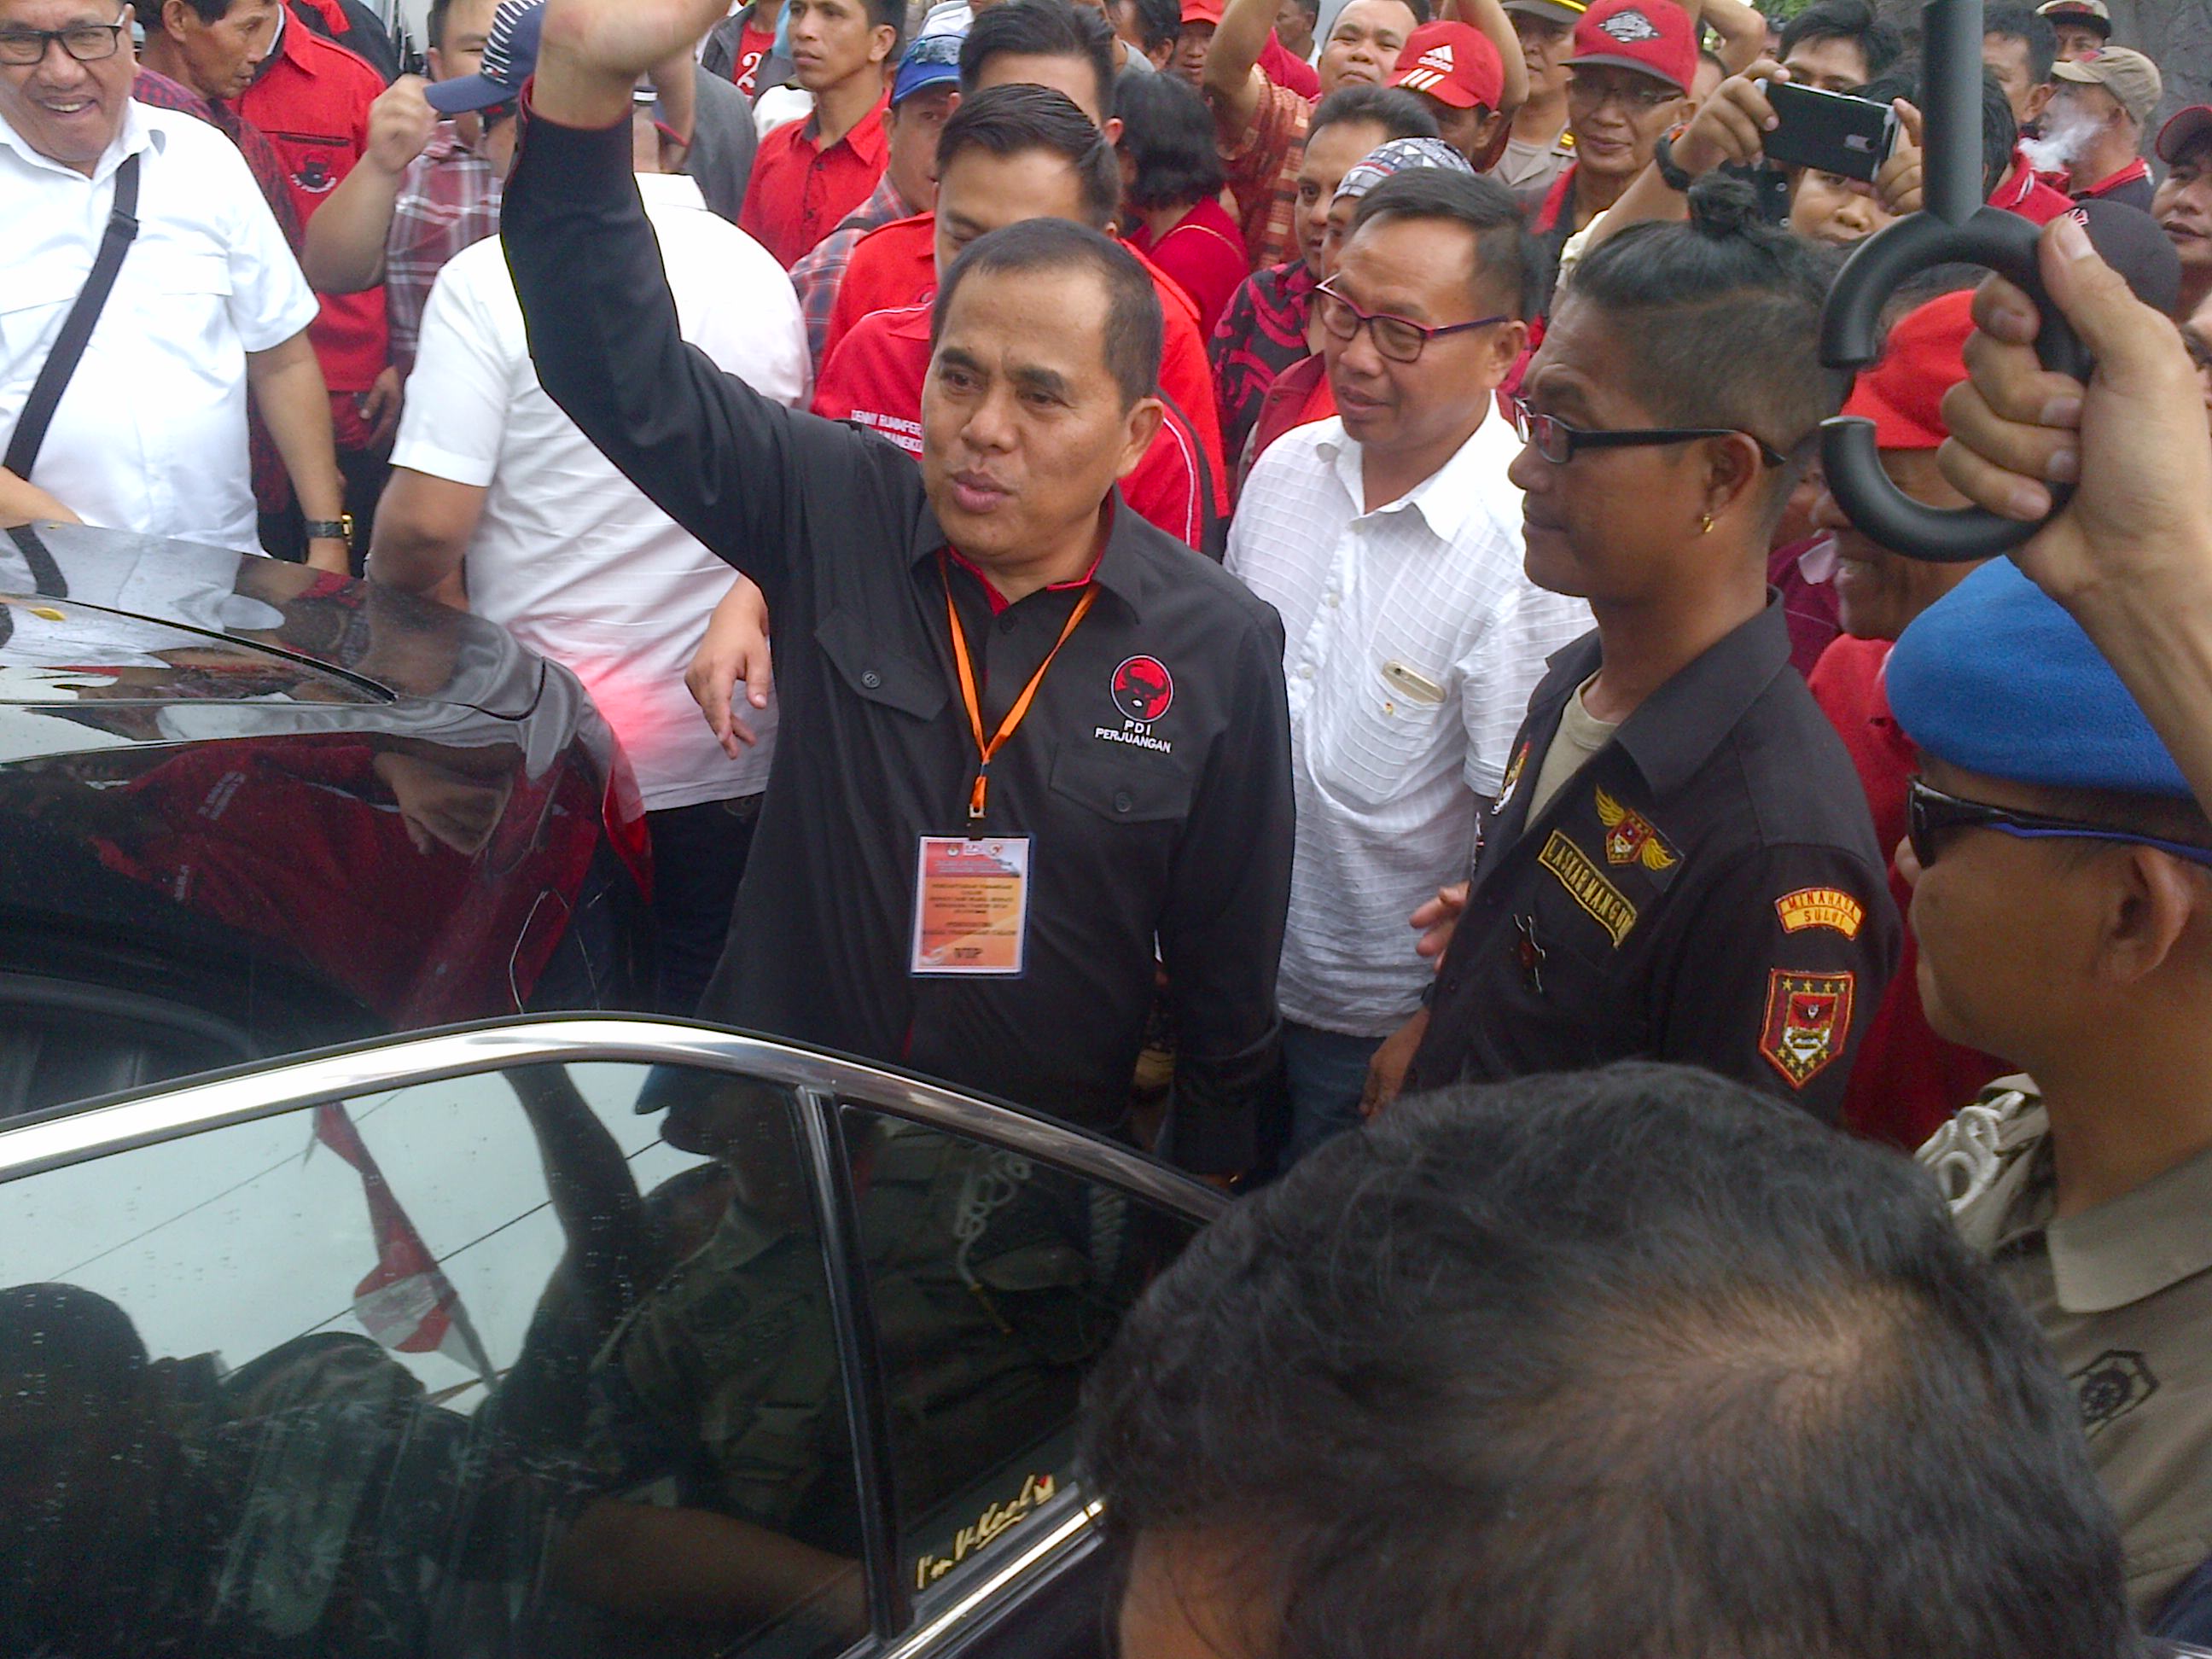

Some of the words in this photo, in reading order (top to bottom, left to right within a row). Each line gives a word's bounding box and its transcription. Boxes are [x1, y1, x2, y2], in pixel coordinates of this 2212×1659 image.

[736, 52, 763, 89] 2
[1417, 55, 1453, 73] adidas
[1095, 728, 1171, 753] PERJUANGAN
[1124, 720, 1151, 736] PDI
[1547, 839, 1590, 892] LASKAR
[1788, 891, 1855, 919] MINAHASA
